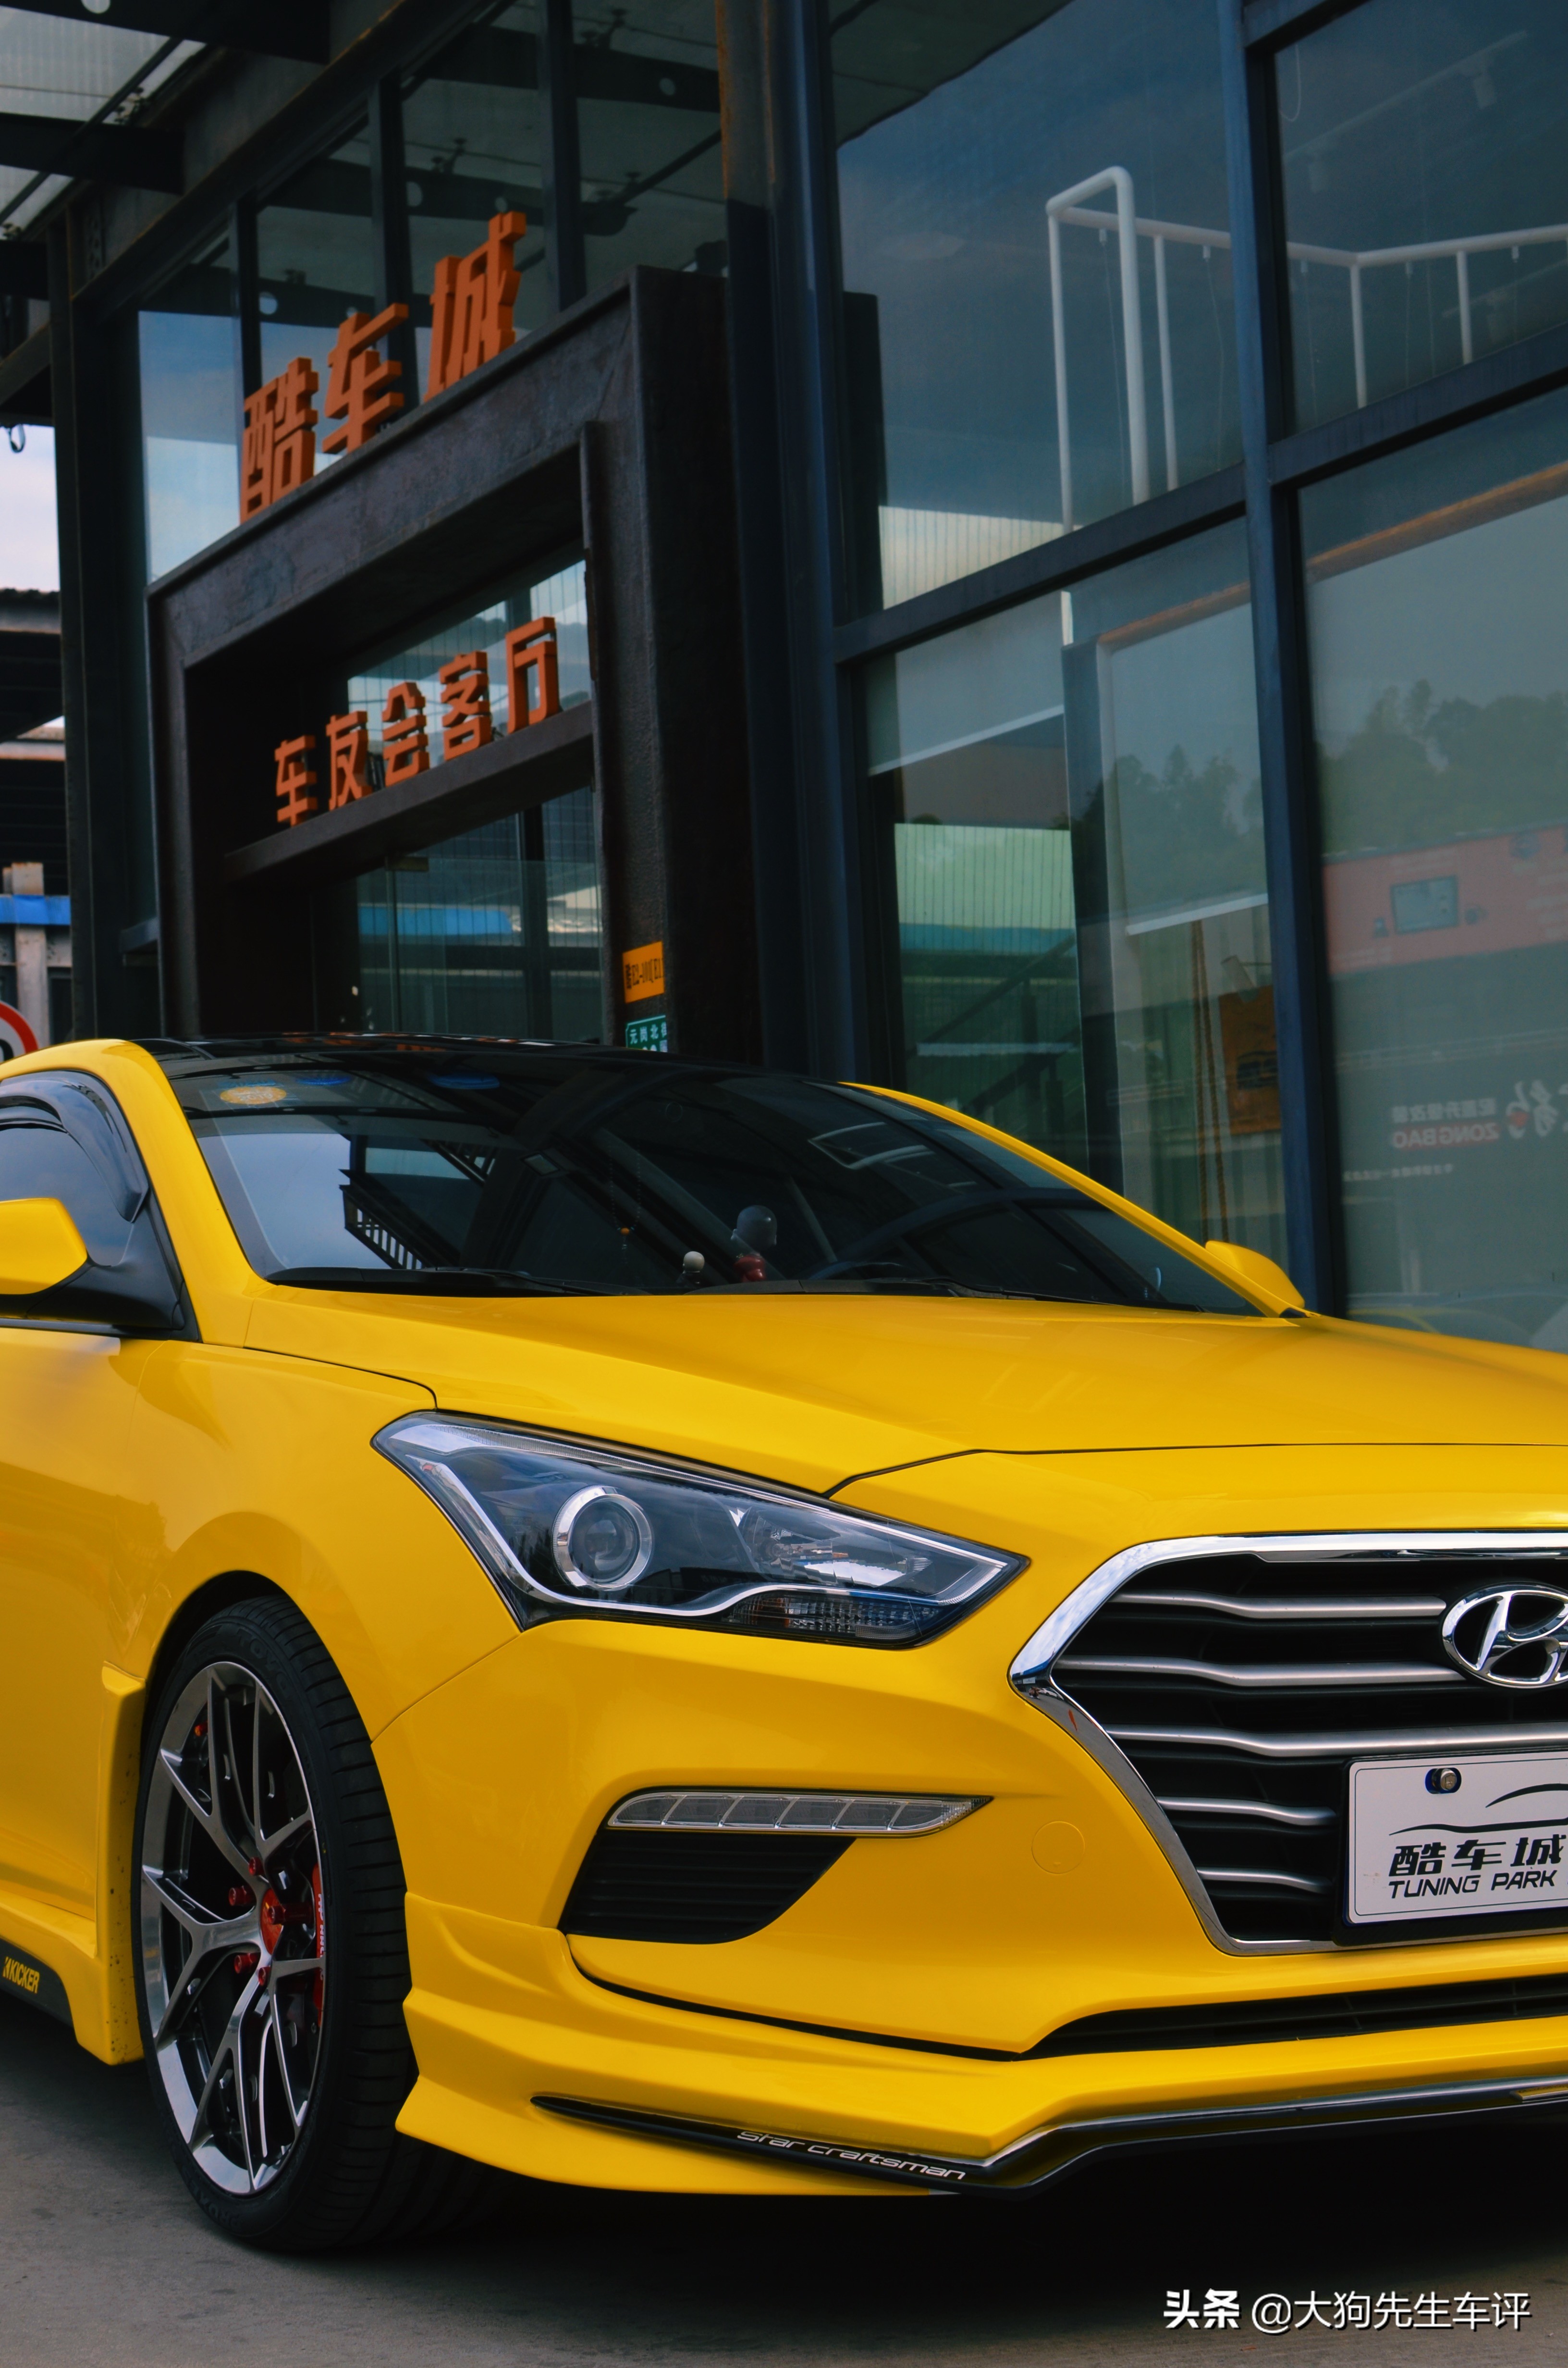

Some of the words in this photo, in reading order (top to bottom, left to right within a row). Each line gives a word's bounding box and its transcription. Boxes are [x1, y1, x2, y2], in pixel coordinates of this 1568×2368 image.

[240, 211, 526, 525] 酷车城
[275, 617, 559, 826] 车友会客厅
[1388, 1834, 1567, 1876] 酷车城
[1388, 1875, 1481, 1899] TUNING
[1491, 1870, 1557, 1891] PARK
[807, 2145, 966, 2180] craftsman
